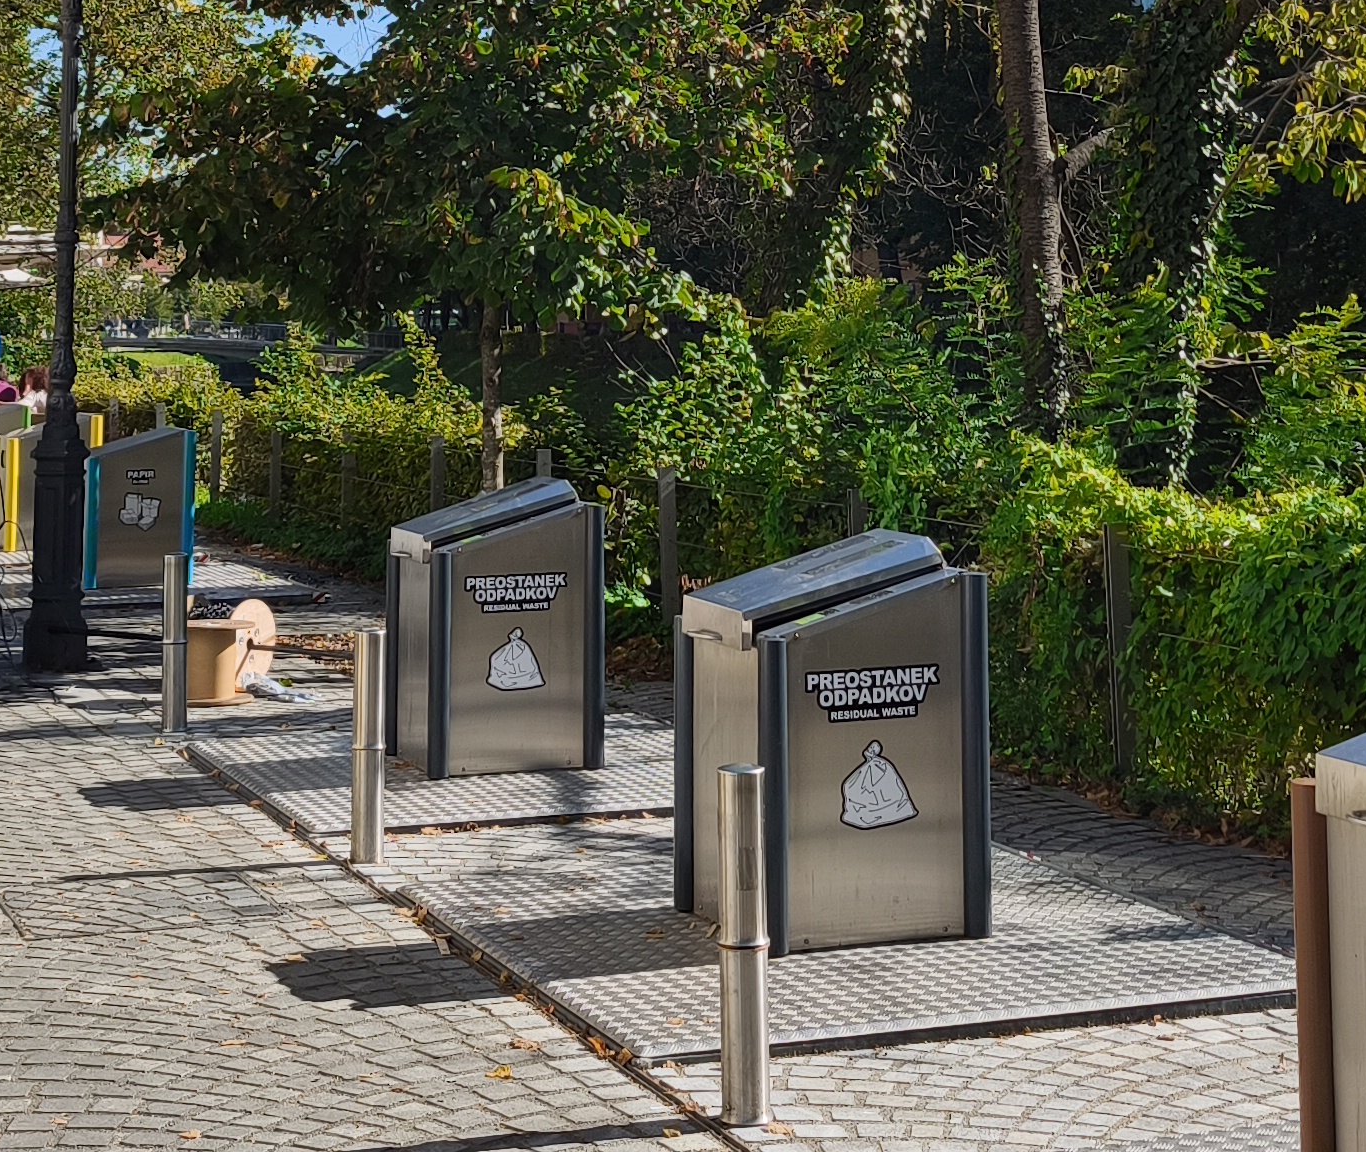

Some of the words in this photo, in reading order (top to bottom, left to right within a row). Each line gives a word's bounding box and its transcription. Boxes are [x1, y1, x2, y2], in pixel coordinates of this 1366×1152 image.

[466, 573, 566, 590] PREOSTANEK
[475, 586, 557, 602] ODPADKOV
[483, 603, 521, 612] RESIDUAL
[522, 601, 549, 610] WASTE
[806, 666, 938, 691] PREOSTANEK
[819, 684, 927, 707] ODPADKOV
[830, 708, 880, 721] RESIDUAL
[882, 706, 916, 717] WASTE
